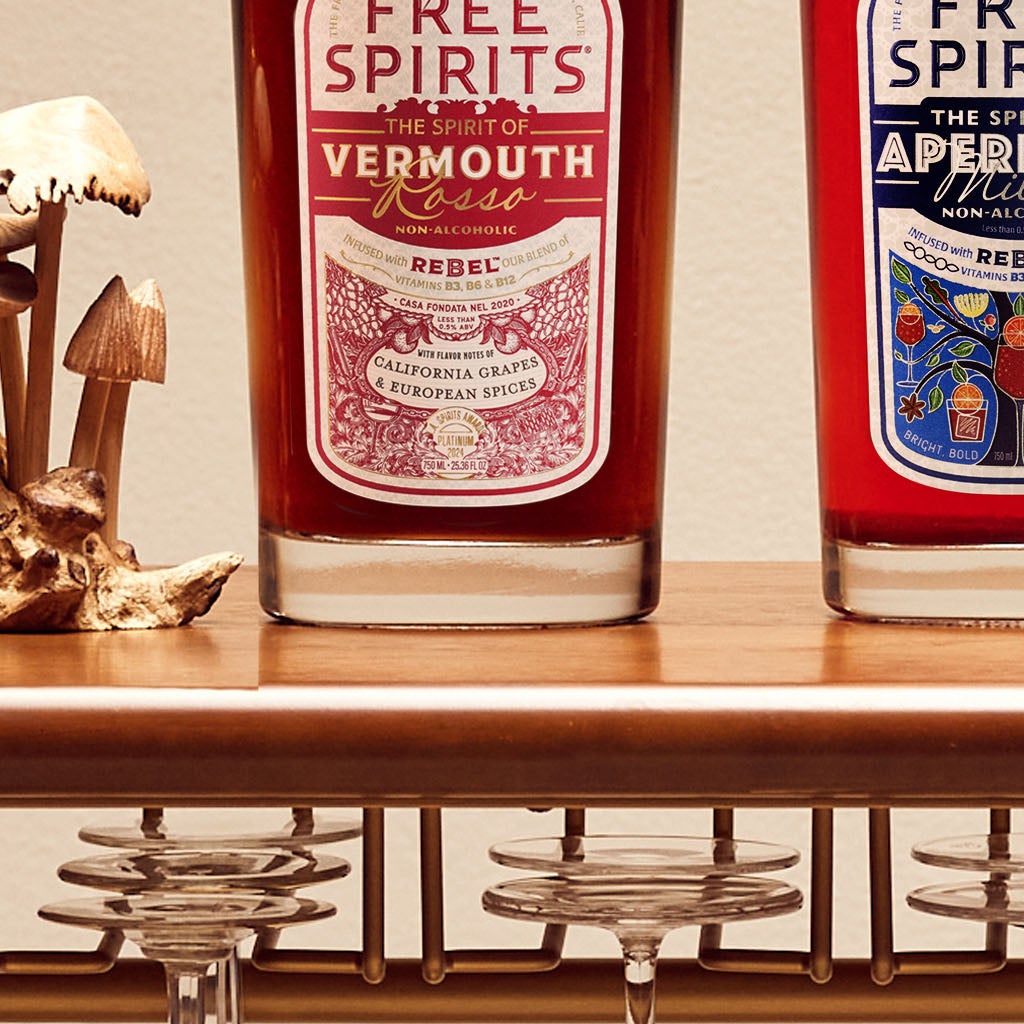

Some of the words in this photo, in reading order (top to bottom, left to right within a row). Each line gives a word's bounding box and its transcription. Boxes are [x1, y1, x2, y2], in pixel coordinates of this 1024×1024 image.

[329, 15, 338, 37] THE
[892, 9, 902, 31] THE
[931, 109, 979, 126] THE
[385, 118, 425, 135] THE
[432, 118, 497, 136] SPIRIT
[501, 118, 529, 135] OF
[321, 143, 594, 180] VERMOUTH
[370, 154, 537, 220] Rosso
[395, 225, 517, 235] NON-ALCOHOLIC
[998, 224, 1015, 234] than
[343, 234, 383, 259] INFUSED
[385, 253, 408, 267] with
[502, 255, 525, 268] OUR
[527, 243, 557, 262] BLEND
[559, 234, 570, 247] of
[908, 226, 949, 252] INFUSED
[950, 246, 973, 259] with
[961, 266, 1008, 282] VITAMINS
[395, 275, 442, 291] VITAMINS
[445, 281, 464, 292] B3,
[466, 280, 482, 291] B6
[484, 279, 493, 289] &
[496, 275, 517, 288] B12
[399, 297, 424, 311] CASA
[426, 303, 468, 313] FONDATA
[470, 304, 489, 313] NEL
[491, 298, 515, 310] 2020
[417, 349, 435, 358] WITH
[436, 351, 462, 360] FLAVOR
[463, 350, 485, 360] NOTES
[486, 349, 494, 358] OF
[374, 355, 474, 380] CALIFORNIA
[479, 356, 539, 379] GRAPES
[375, 377, 385, 389] &
[390, 381, 477, 400] EUROPEAN
[483, 378, 537, 399] SPICES
[437, 435, 474, 446] PLATINUM
[949, 448, 979, 460] BOLD
[423, 460, 436, 470] 750
[436, 460, 446, 470] ML
[470, 461, 477, 470] FL
[478, 460, 487, 470] OZ
